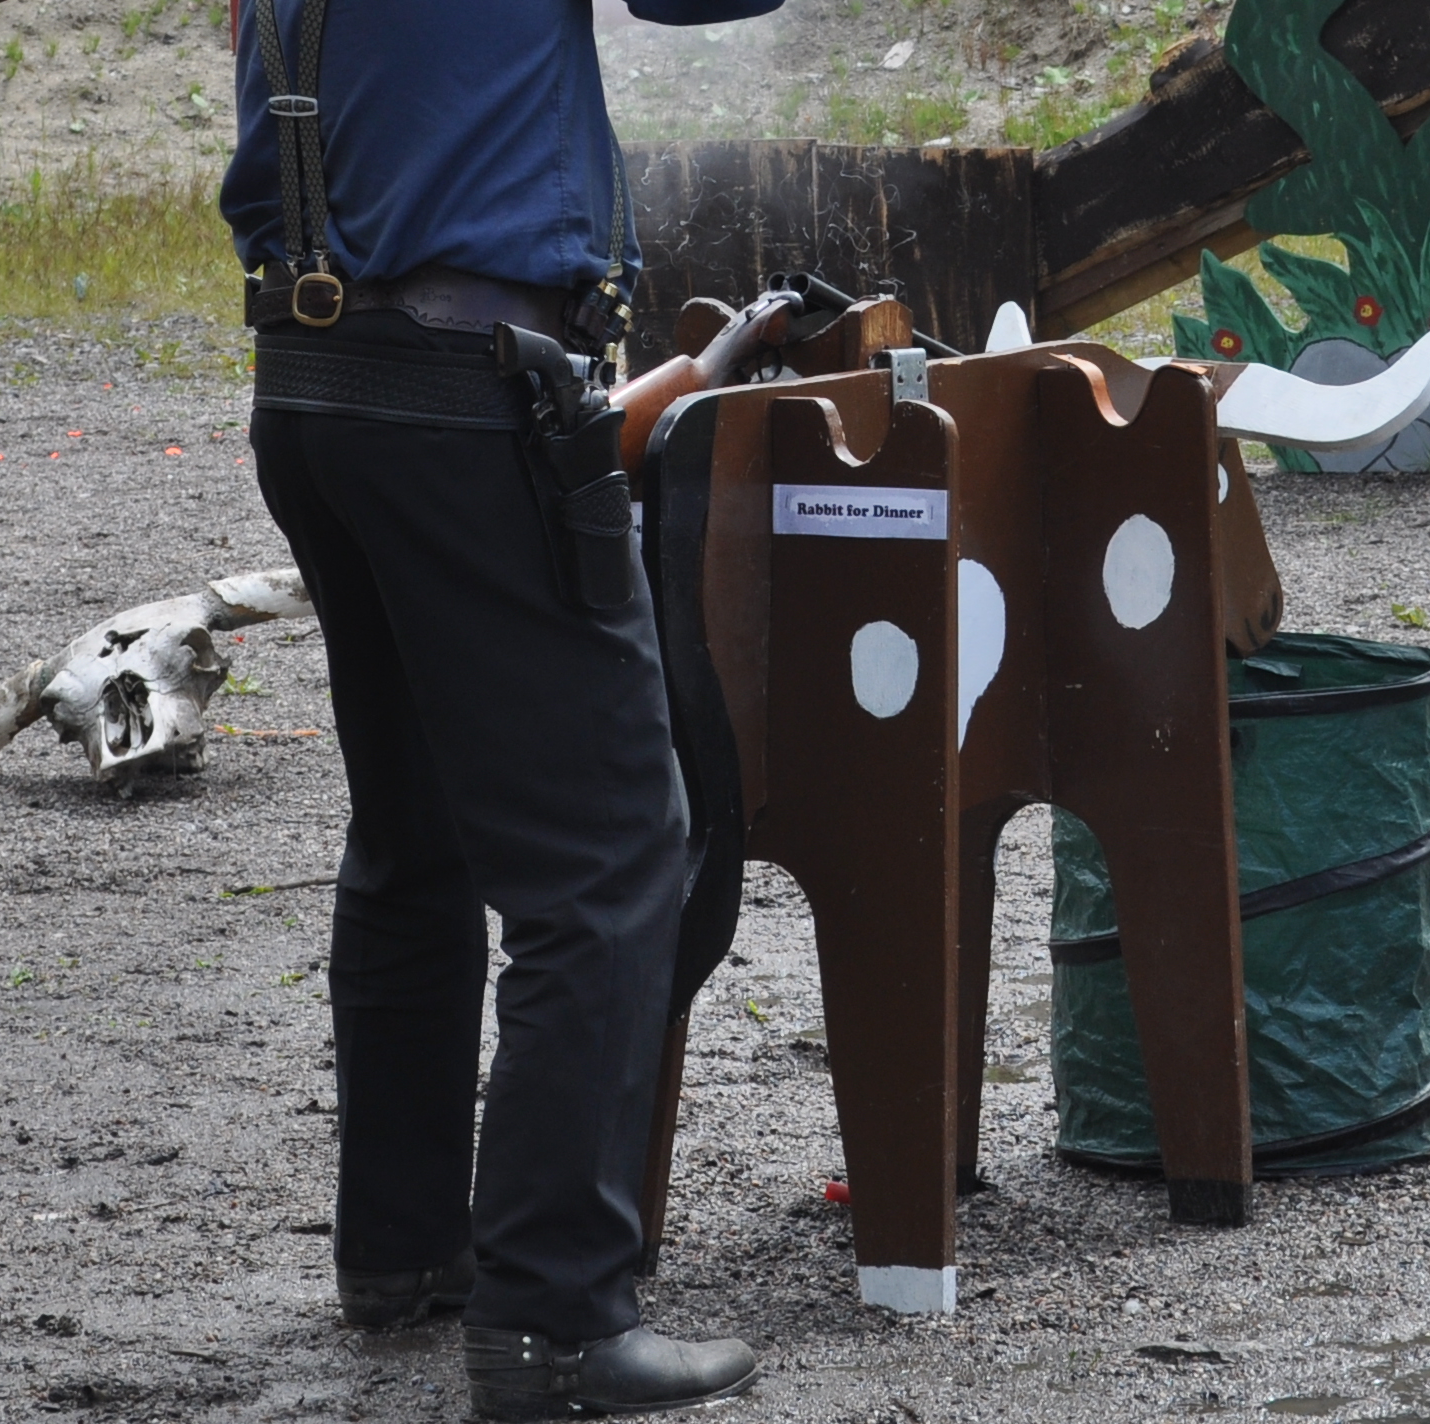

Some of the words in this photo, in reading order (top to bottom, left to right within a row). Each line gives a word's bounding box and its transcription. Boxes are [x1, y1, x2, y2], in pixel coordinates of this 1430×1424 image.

[797, 502, 843, 517] Rabbit
[846, 504, 869, 517] for
[873, 505, 924, 519] Dinner
